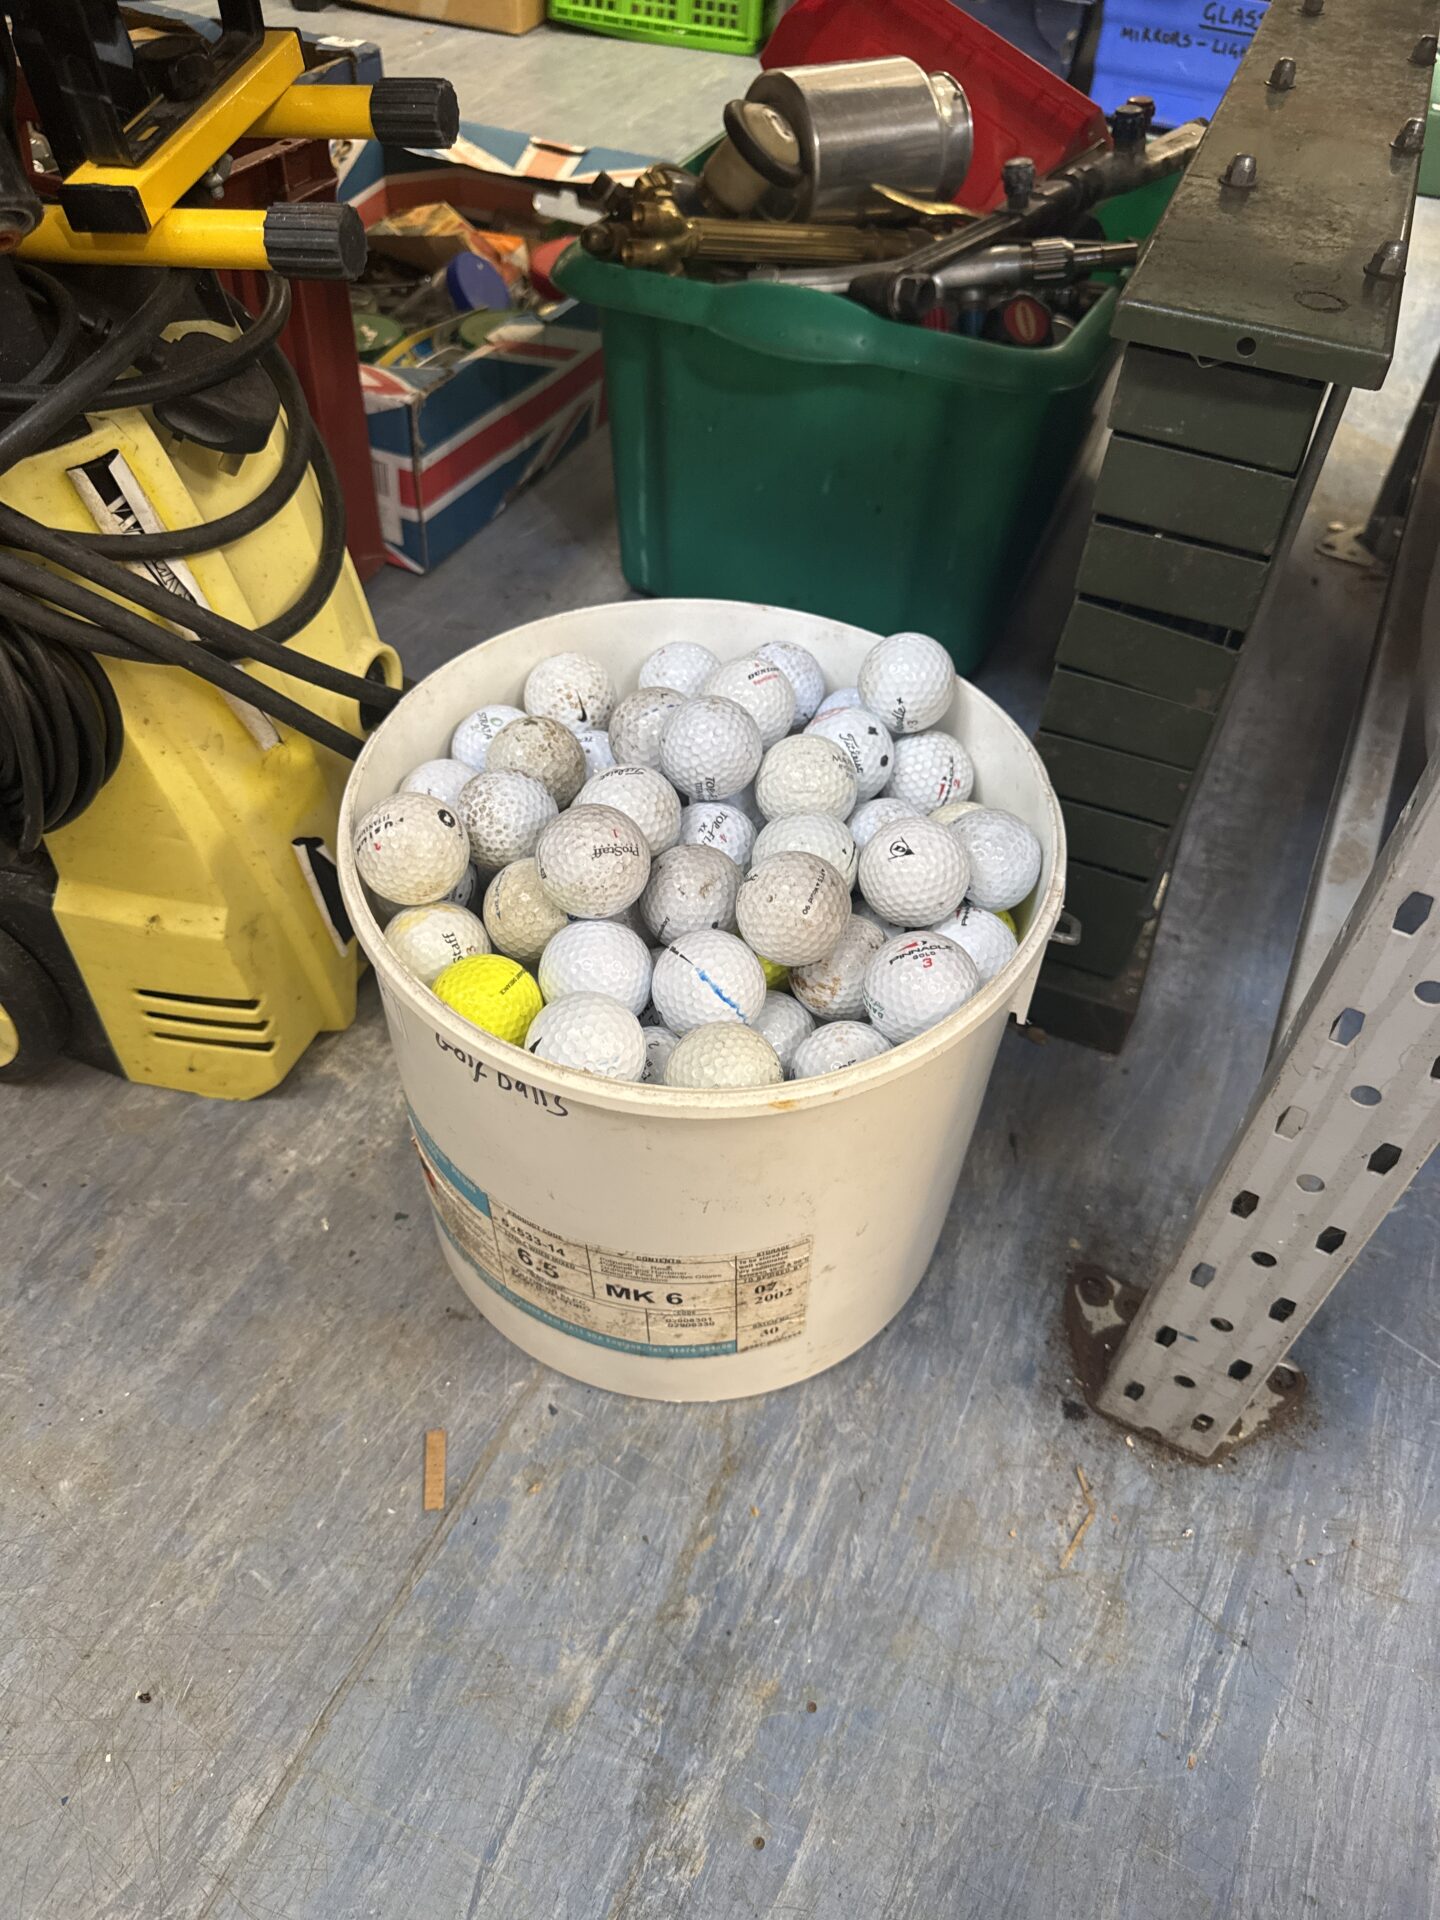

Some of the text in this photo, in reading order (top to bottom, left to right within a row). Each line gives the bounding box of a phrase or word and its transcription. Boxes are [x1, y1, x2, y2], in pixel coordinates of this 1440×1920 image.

[1121, 26, 1193, 48] MIRRORS
[838, 732, 865, 777] Titleist
[592, 845, 640, 861] ProStaff
[888, 943, 955, 966] PINNACLE
[912, 950, 937, 961] GOLD
[922, 957, 933, 969] 3
[517, 1247, 560, 1280] 6.5
[605, 1283, 684, 1305] MK 6
[754, 1287, 793, 1305] 2002
